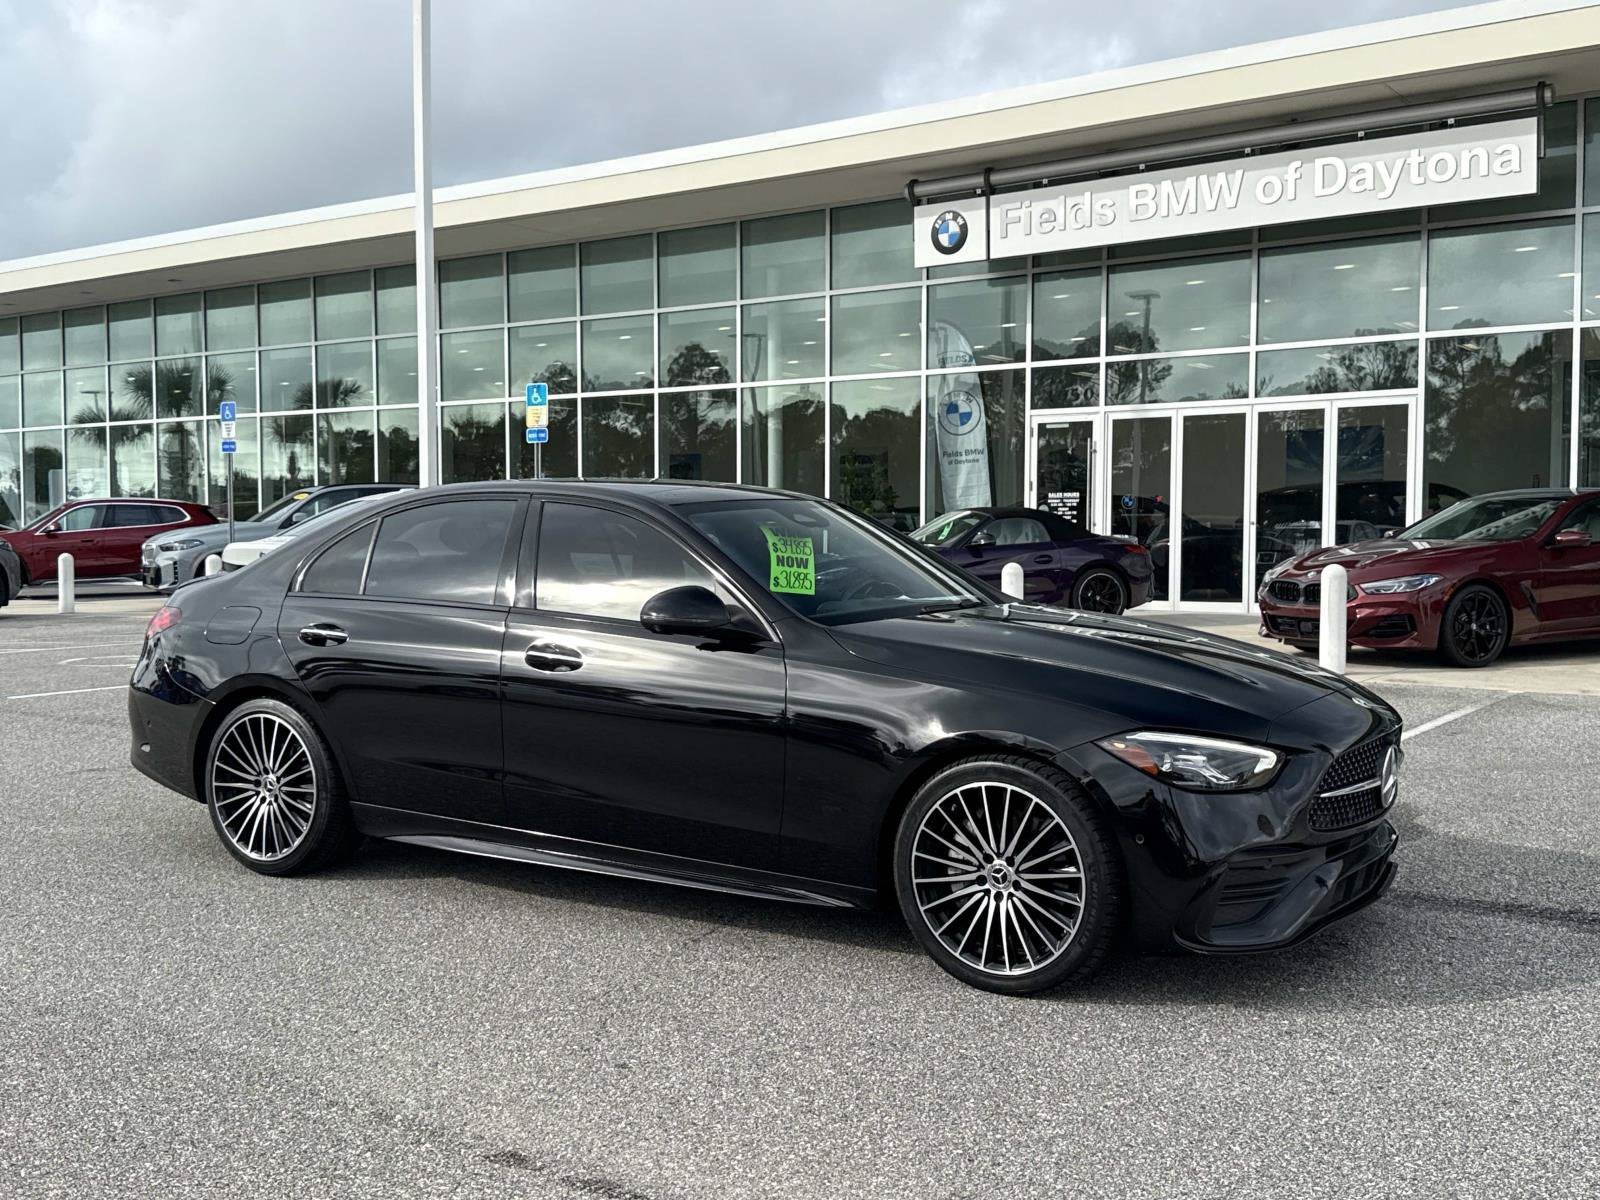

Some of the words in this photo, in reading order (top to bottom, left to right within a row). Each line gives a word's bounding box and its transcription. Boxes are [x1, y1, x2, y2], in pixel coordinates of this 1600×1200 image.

[999, 190, 1116, 240] Fields
[1127, 168, 1246, 222] BMW
[1255, 158, 1303, 206] of
[1313, 141, 1521, 199] Daytona
[934, 212, 965, 229] BMW
[943, 450, 963, 458] Fields
[964, 448, 984, 456] BMW
[776, 555, 809, 569] NOW
